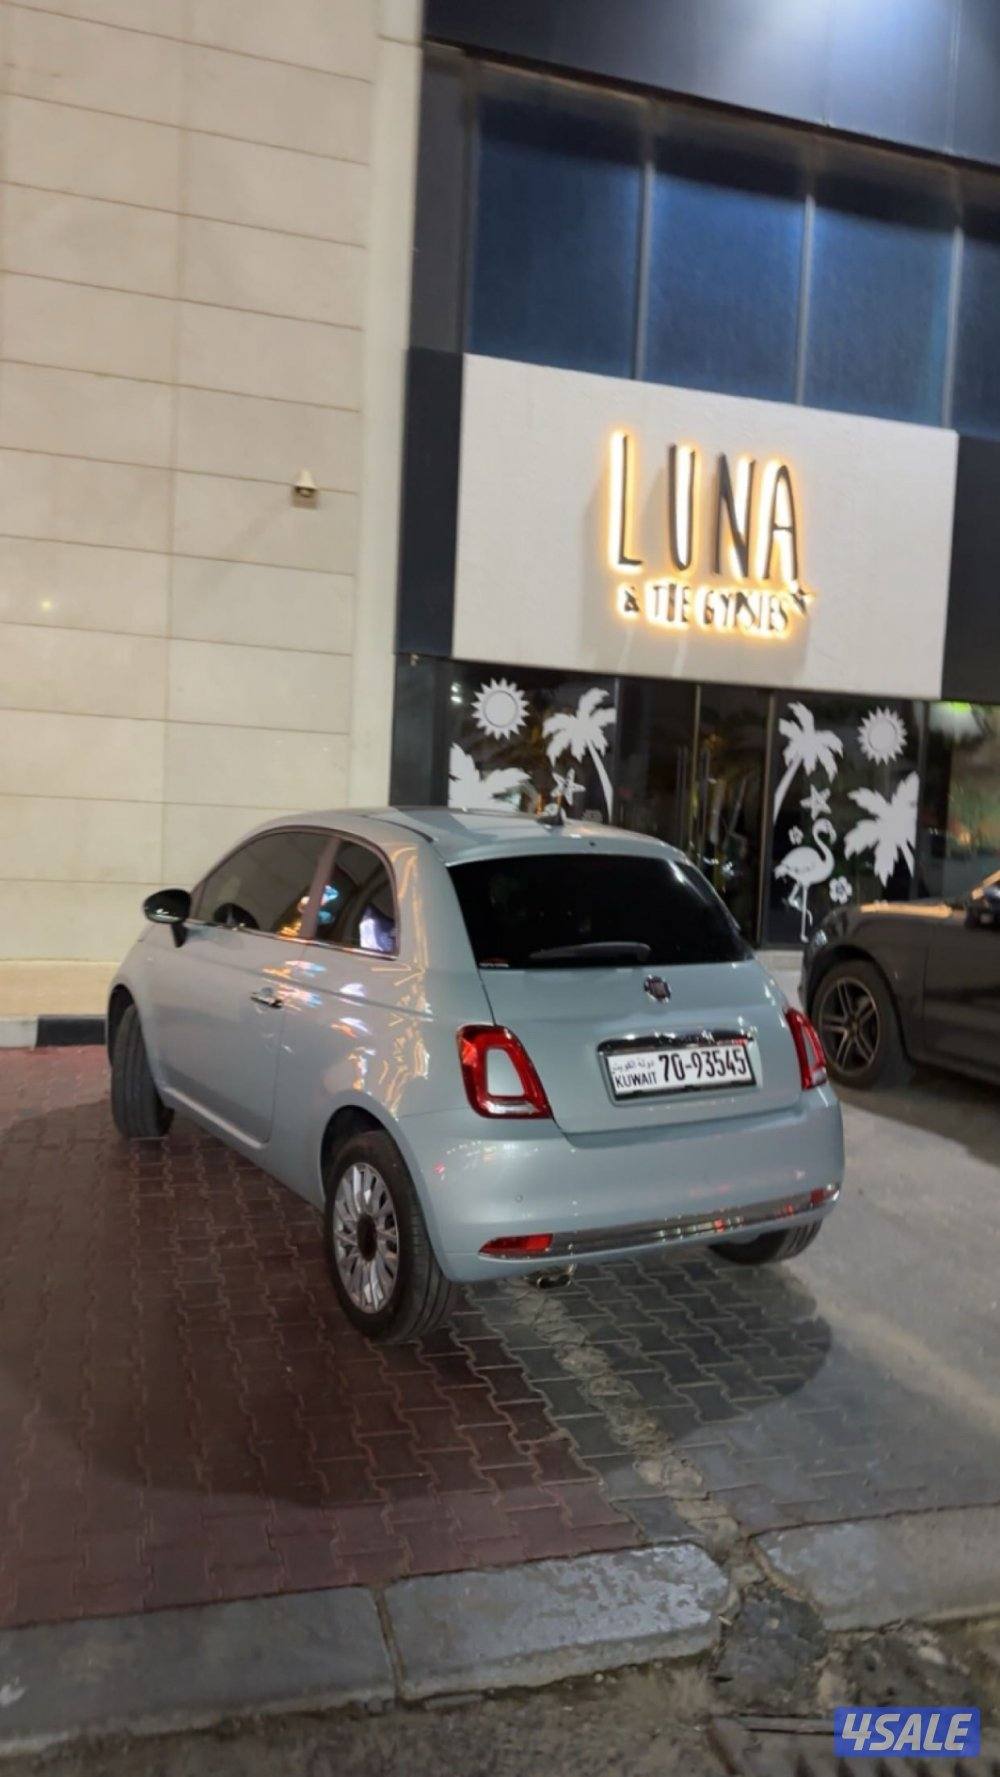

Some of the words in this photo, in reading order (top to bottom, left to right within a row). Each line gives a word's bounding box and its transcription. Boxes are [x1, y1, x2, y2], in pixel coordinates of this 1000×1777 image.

[616, 433, 798, 580] LUNA
[623, 586, 640, 612] &
[653, 582, 690, 623] THE
[615, 1072, 657, 1088] KUWAIT
[659, 1049, 747, 1082] 70-93545
